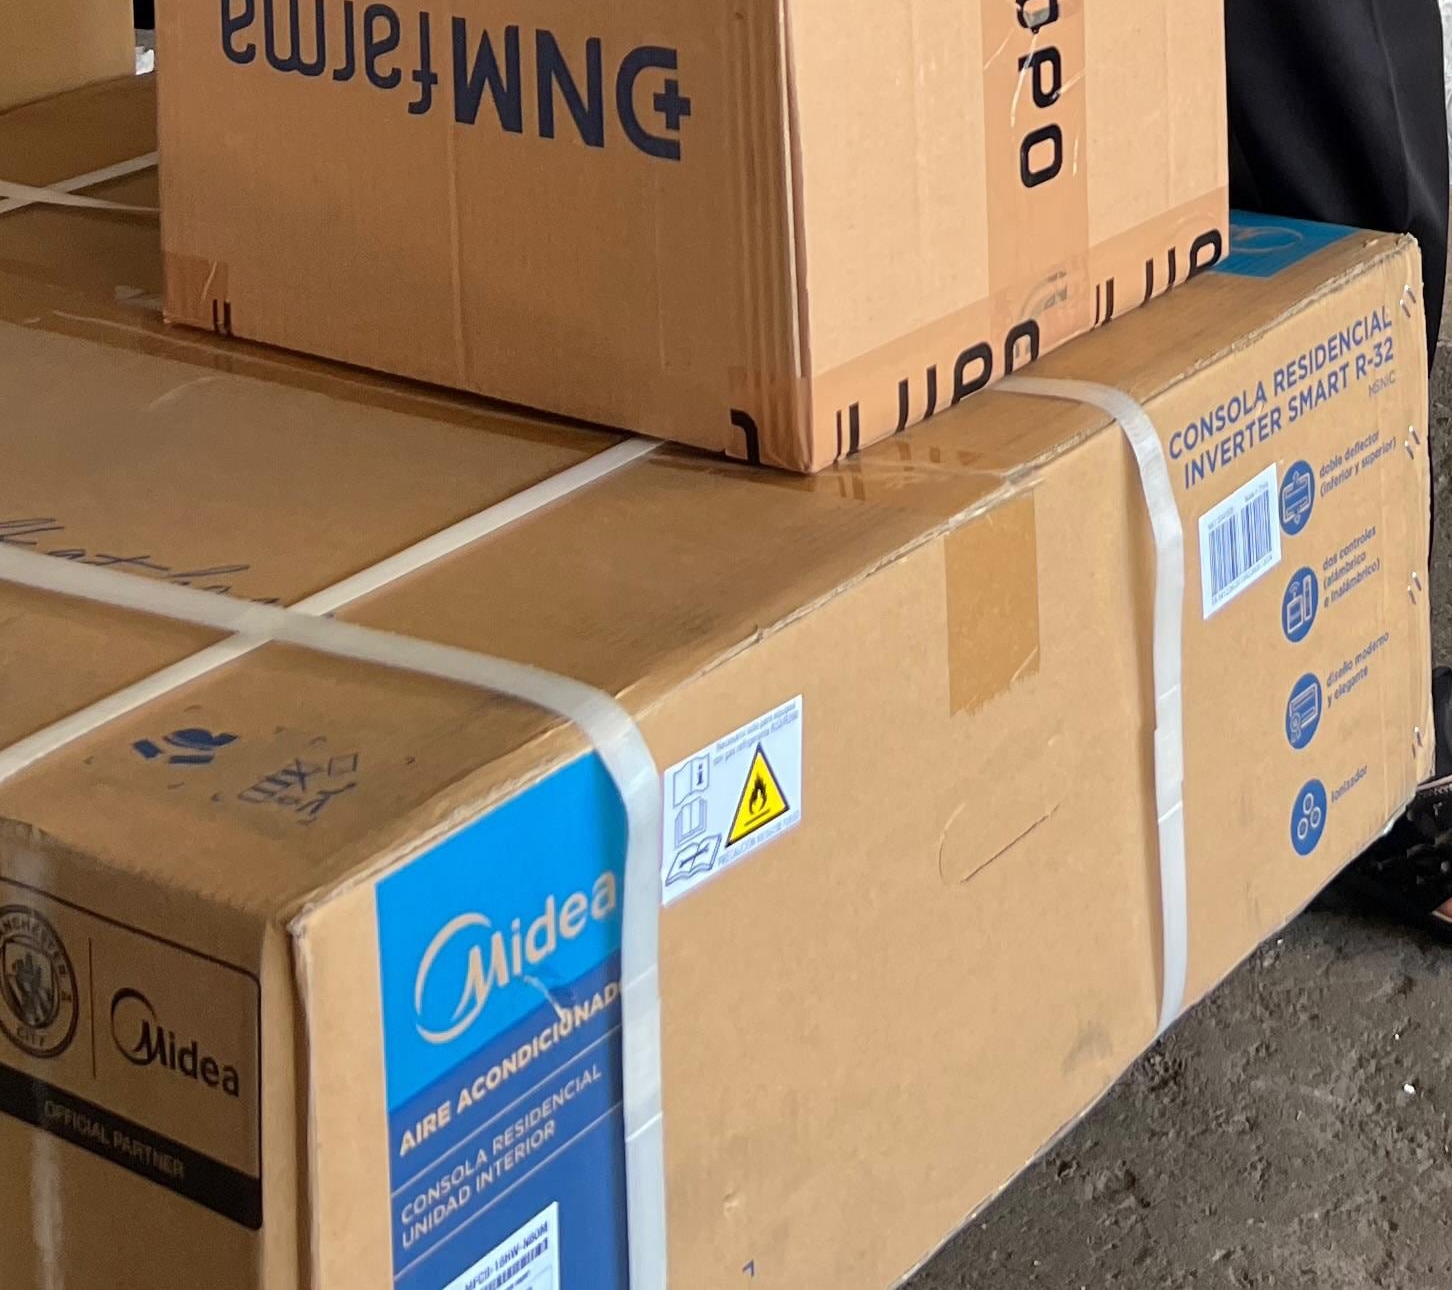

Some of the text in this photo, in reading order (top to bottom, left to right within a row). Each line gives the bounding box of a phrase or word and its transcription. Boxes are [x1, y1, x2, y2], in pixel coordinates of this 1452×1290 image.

[1168, 304, 1393, 461] CONSOLA RESIDENCIAL
[1184, 335, 1394, 490] INVERTER SMART R-32
[414, 870, 617, 1045] Midea
[110, 987, 240, 1098] Midea
[399, 1100, 452, 1158] AIRE
[400, 1063, 603, 1225] CONSOLA RESIDENCIAL
[401, 1119, 557, 1250] UNIDAD INTERIOR
